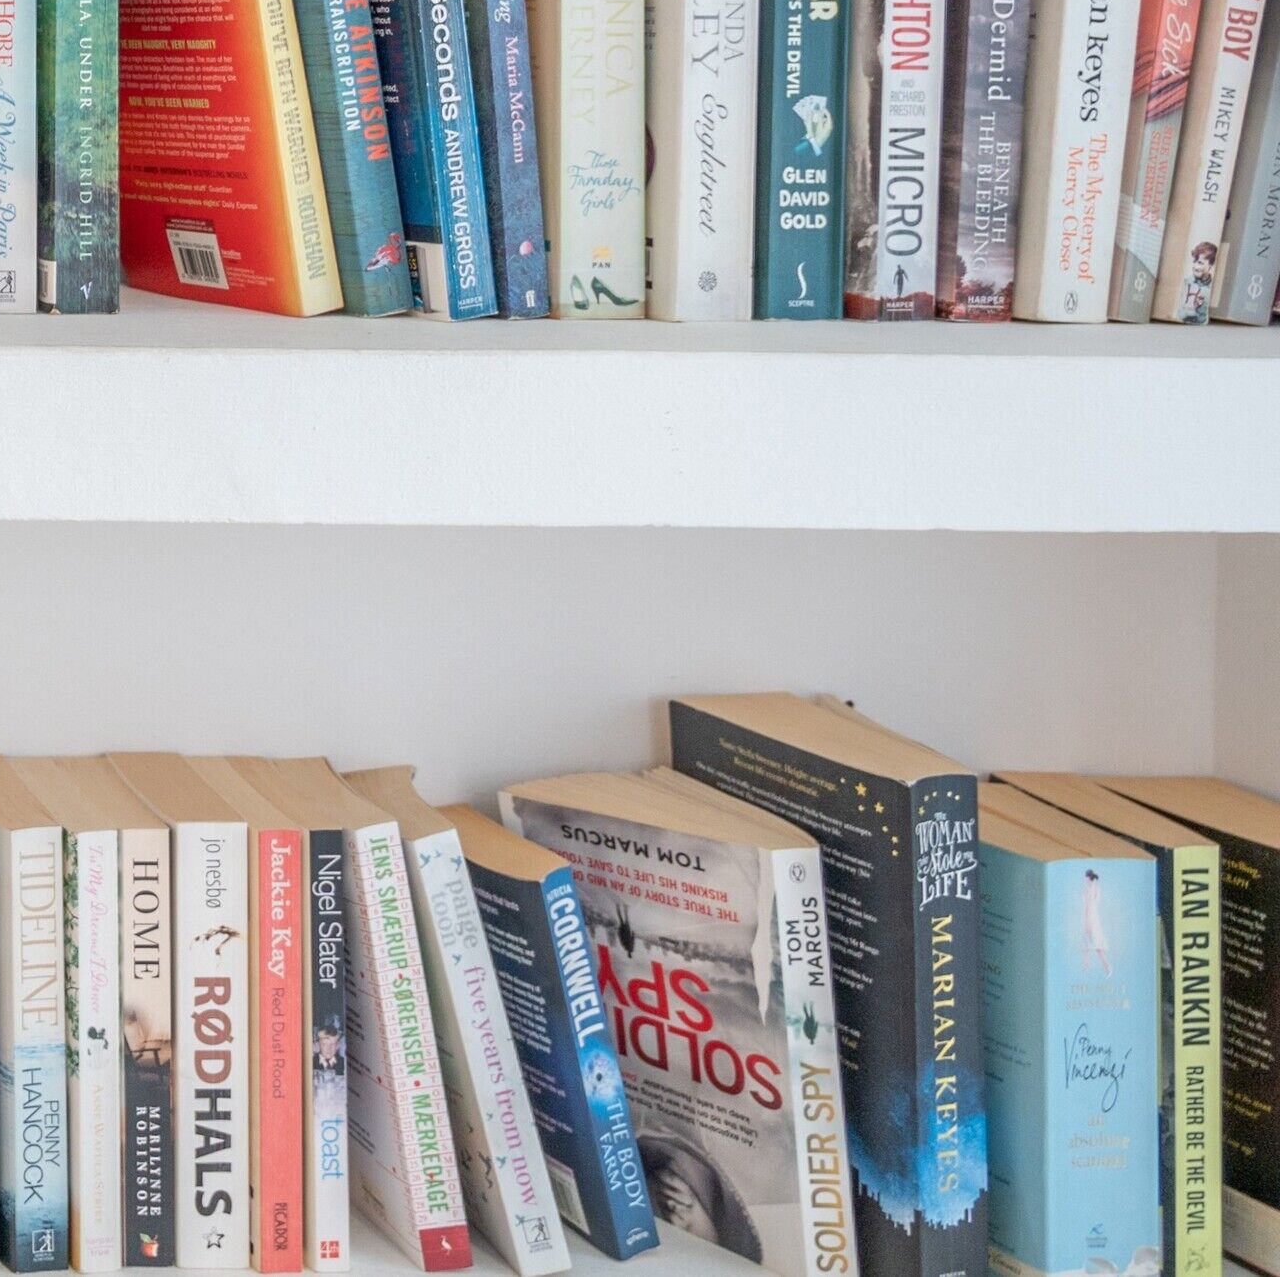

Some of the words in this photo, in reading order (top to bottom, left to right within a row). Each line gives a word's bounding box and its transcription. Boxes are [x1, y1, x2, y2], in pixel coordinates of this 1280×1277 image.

[787, 14, 802, 46] THE
[1222, 8, 1256, 61] BOY
[349, 26, 388, 161] ATKINSON
[786, 50, 801, 97] DEVIL
[1078, 36, 1109, 122] keyes
[1214, 87, 1237, 143] MIKEY
[443, 129, 466, 219] ANDREW
[779, 190, 830, 206] DAVID
[782, 167, 827, 183] GLEN
[885, 127, 926, 257] MICRO
[1202, 149, 1225, 203] WALSH
[780, 212, 827, 229] GOLD
[454, 223, 475, 289] GROSS
[200, 838, 225, 854] jo
[269, 838, 291, 920] Jackie
[205, 859, 226, 908] nesbø
[318, 854, 341, 915] Nigel
[1182, 868, 1210, 918] IAN
[132, 858, 160, 980] HOME
[267, 928, 291, 978] Kay
[318, 922, 340, 988] Slater
[547, 896, 604, 1047] CORNWELL
[930, 915, 955, 1061] MARIAN
[1181, 932, 1210, 1046] RANKIN
[191, 977, 234, 1217] RØDHALS
[800, 1063, 835, 1124] SPY
[136, 1106, 148, 1216] ROBINSON
[149, 1106, 161, 1216] MARILYNNE
[321, 1115, 344, 1179] toast
[934, 1076, 958, 1194] KEYES
[803, 1130, 849, 1275] SOLDIER
